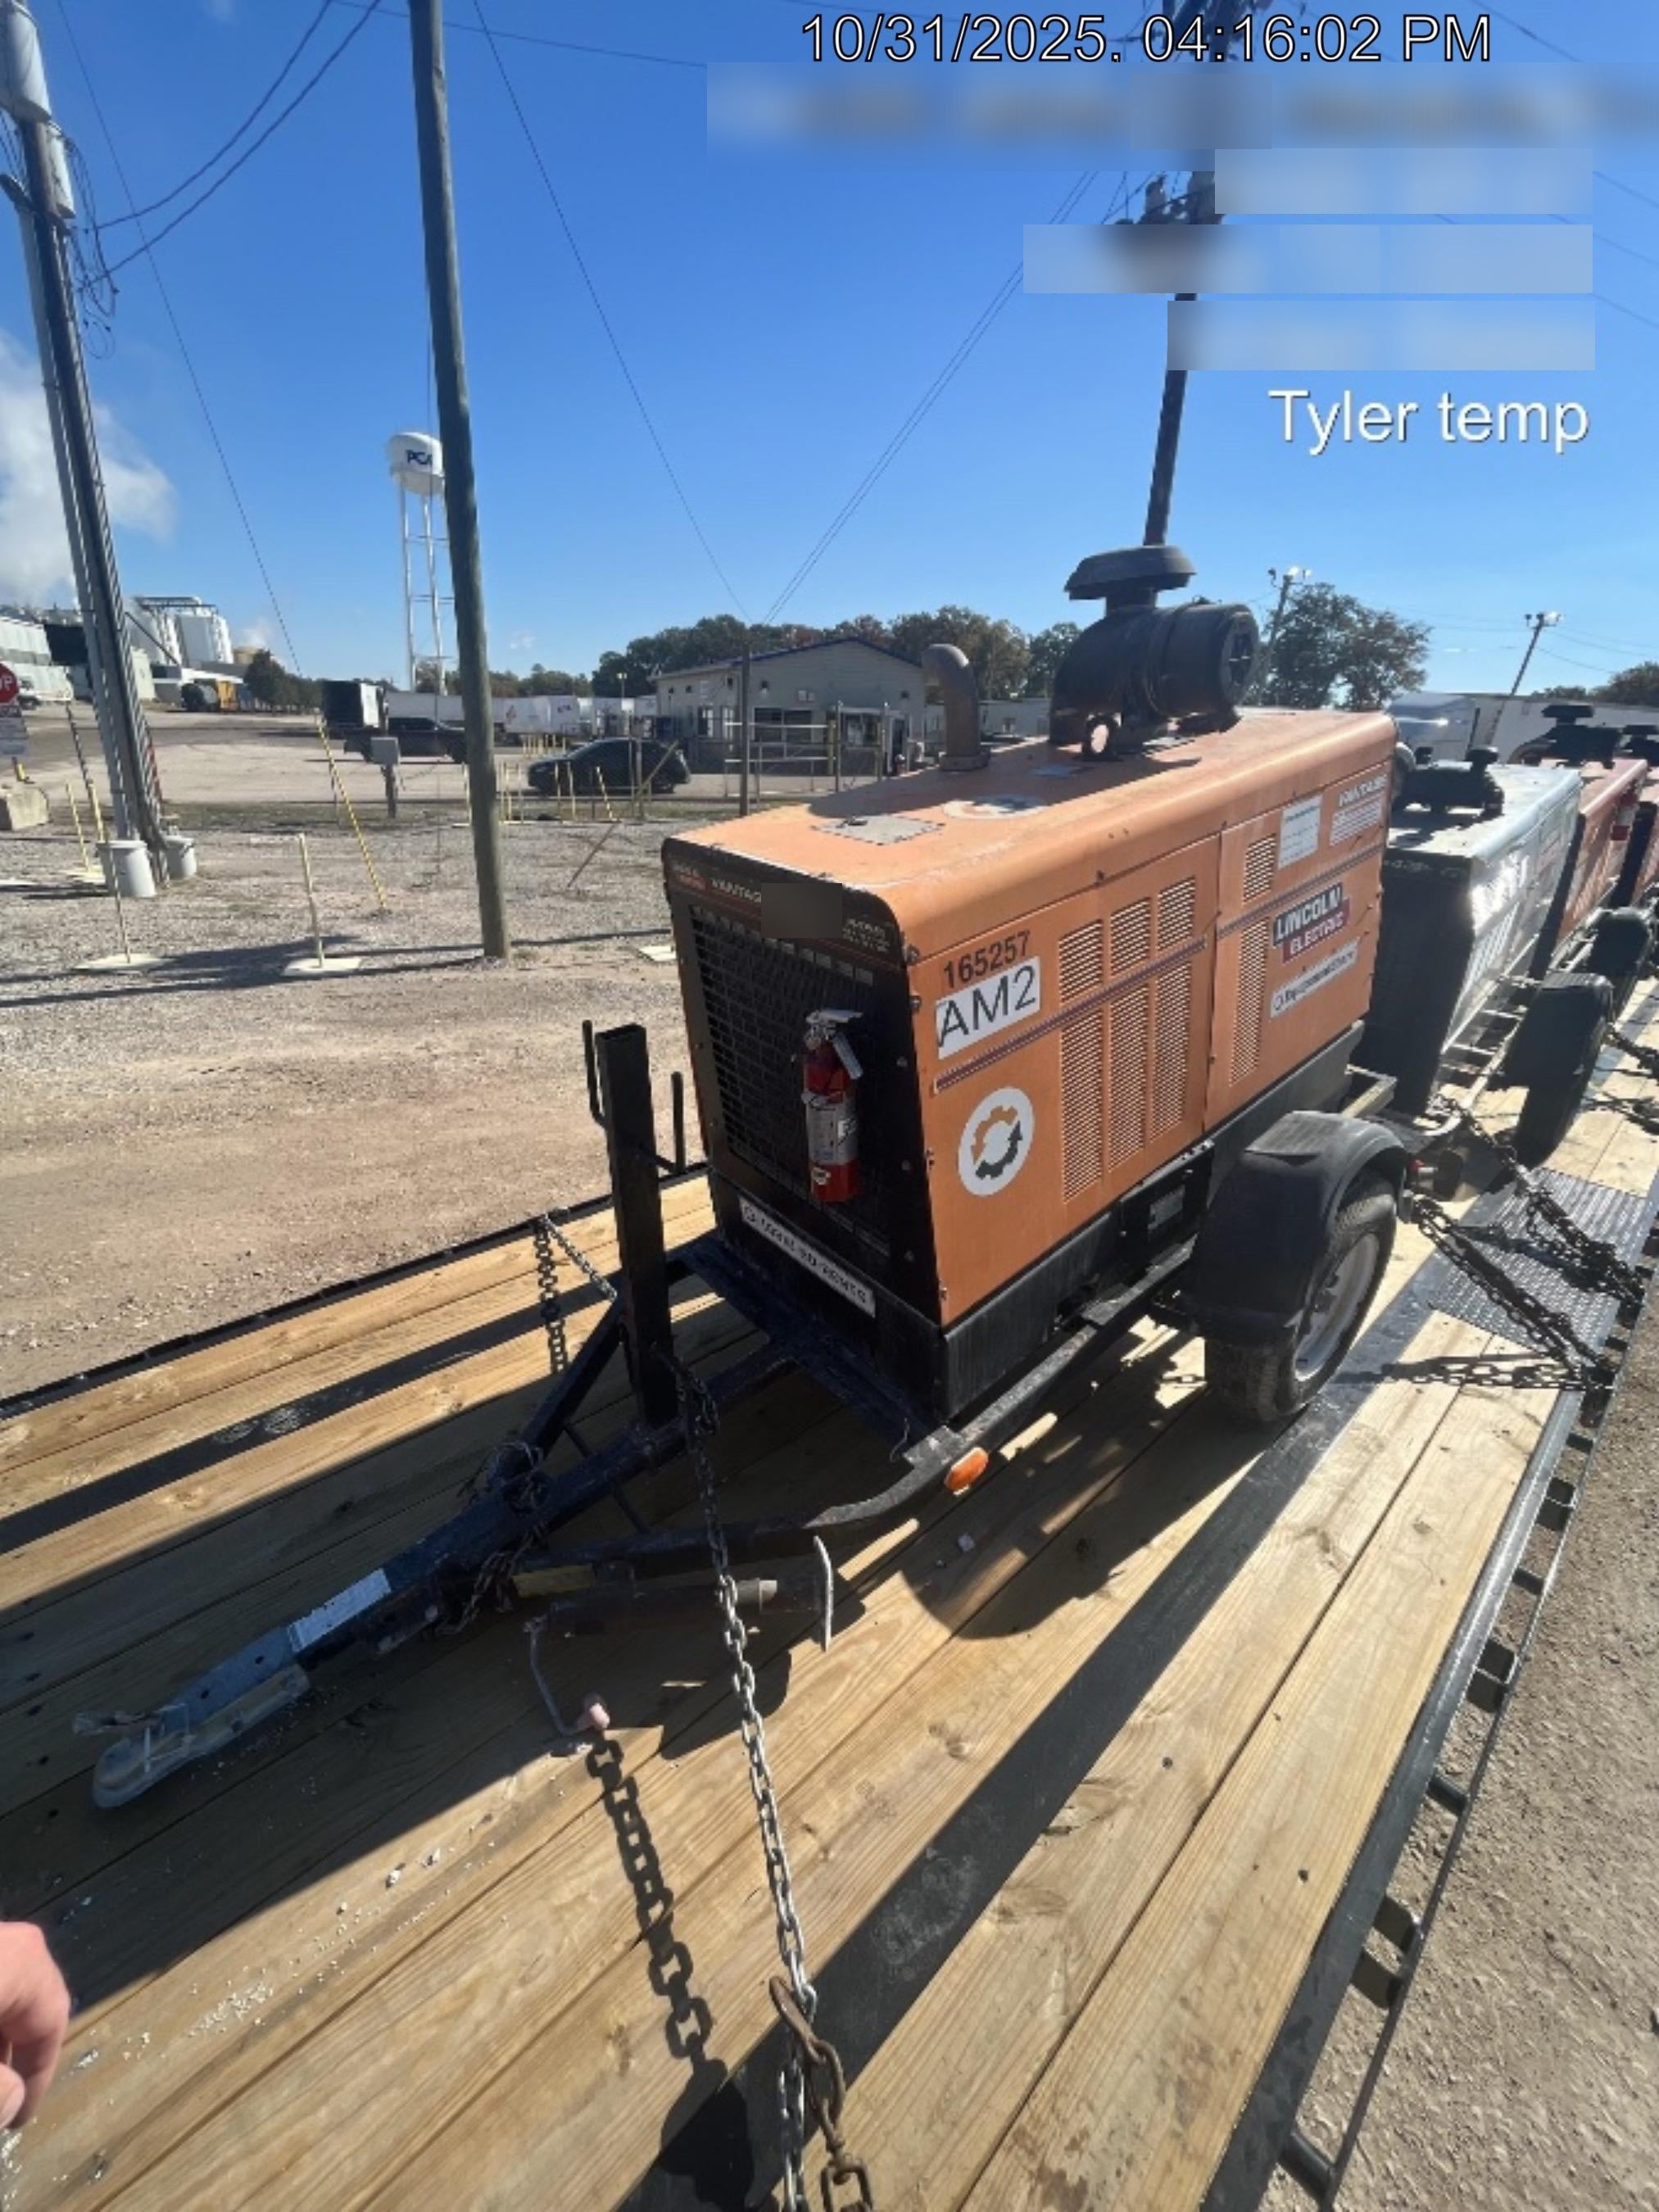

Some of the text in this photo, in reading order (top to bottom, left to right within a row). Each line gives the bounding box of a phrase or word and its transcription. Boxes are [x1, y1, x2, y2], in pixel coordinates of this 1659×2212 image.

[1276, 886, 1341, 941] LINCOLN
[1290, 910, 1344, 955] ELECTRIC
[943, 931, 1030, 988] 165257
[937, 964, 1036, 1047] AM2
